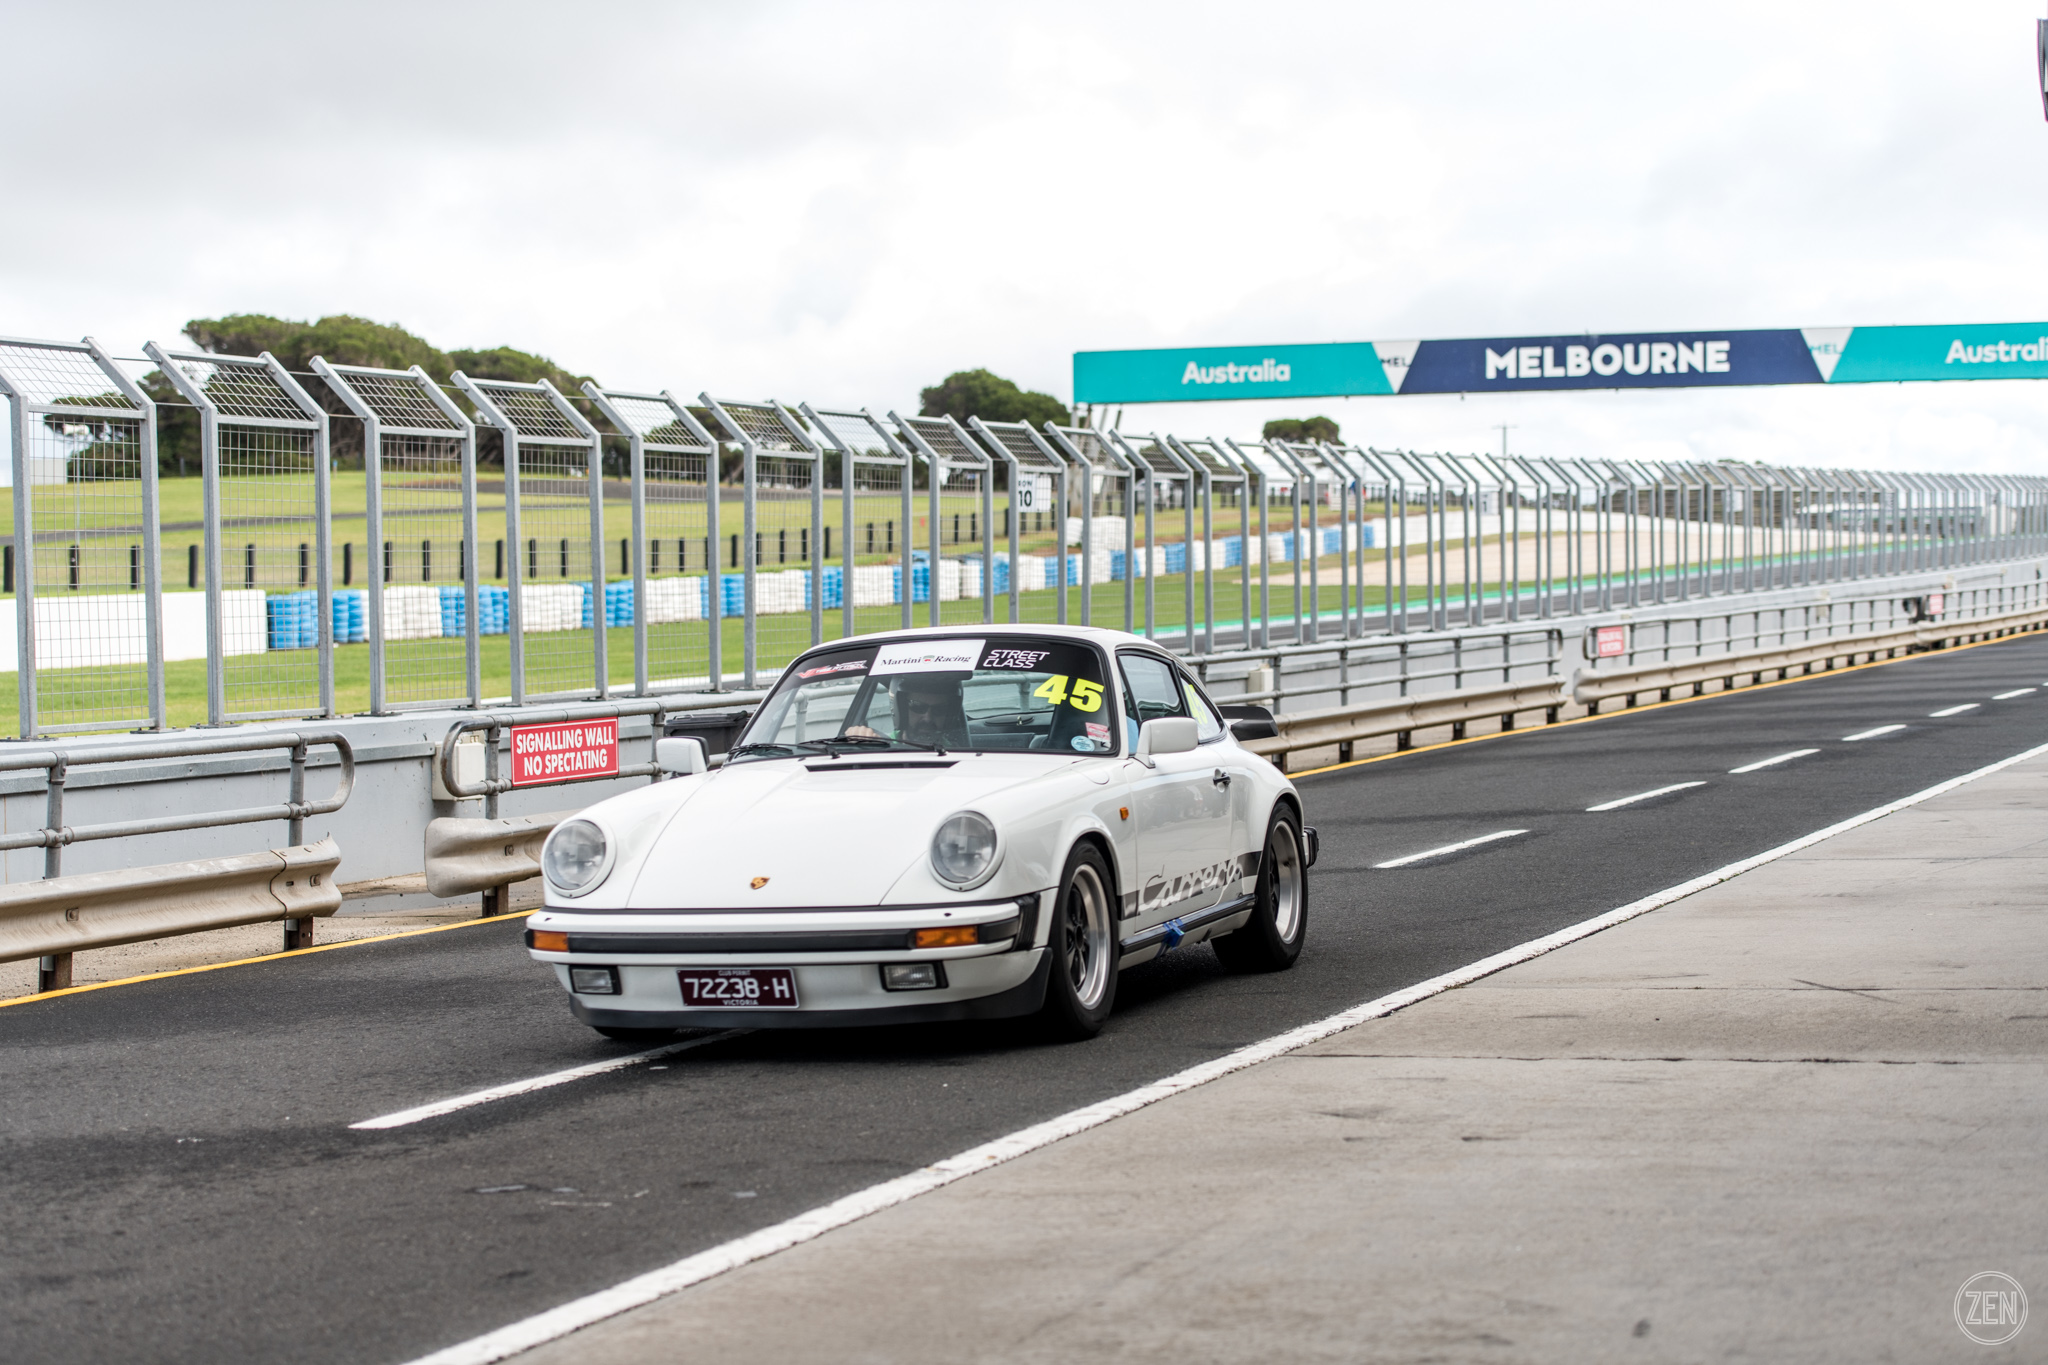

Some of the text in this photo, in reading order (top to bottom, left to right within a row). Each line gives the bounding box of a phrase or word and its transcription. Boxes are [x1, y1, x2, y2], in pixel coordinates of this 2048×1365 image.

[1181, 358, 1291, 384] Australia
[1485, 340, 1731, 379] MELBOURNE
[881, 655, 972, 667] Martini Racing
[983, 658, 1037, 669] CLASS
[988, 649, 1050, 661] STREET
[1033, 674, 1105, 713] 45
[516, 726, 614, 754] SIGNALLING WALL
[524, 748, 608, 776] NO SPECTATING
